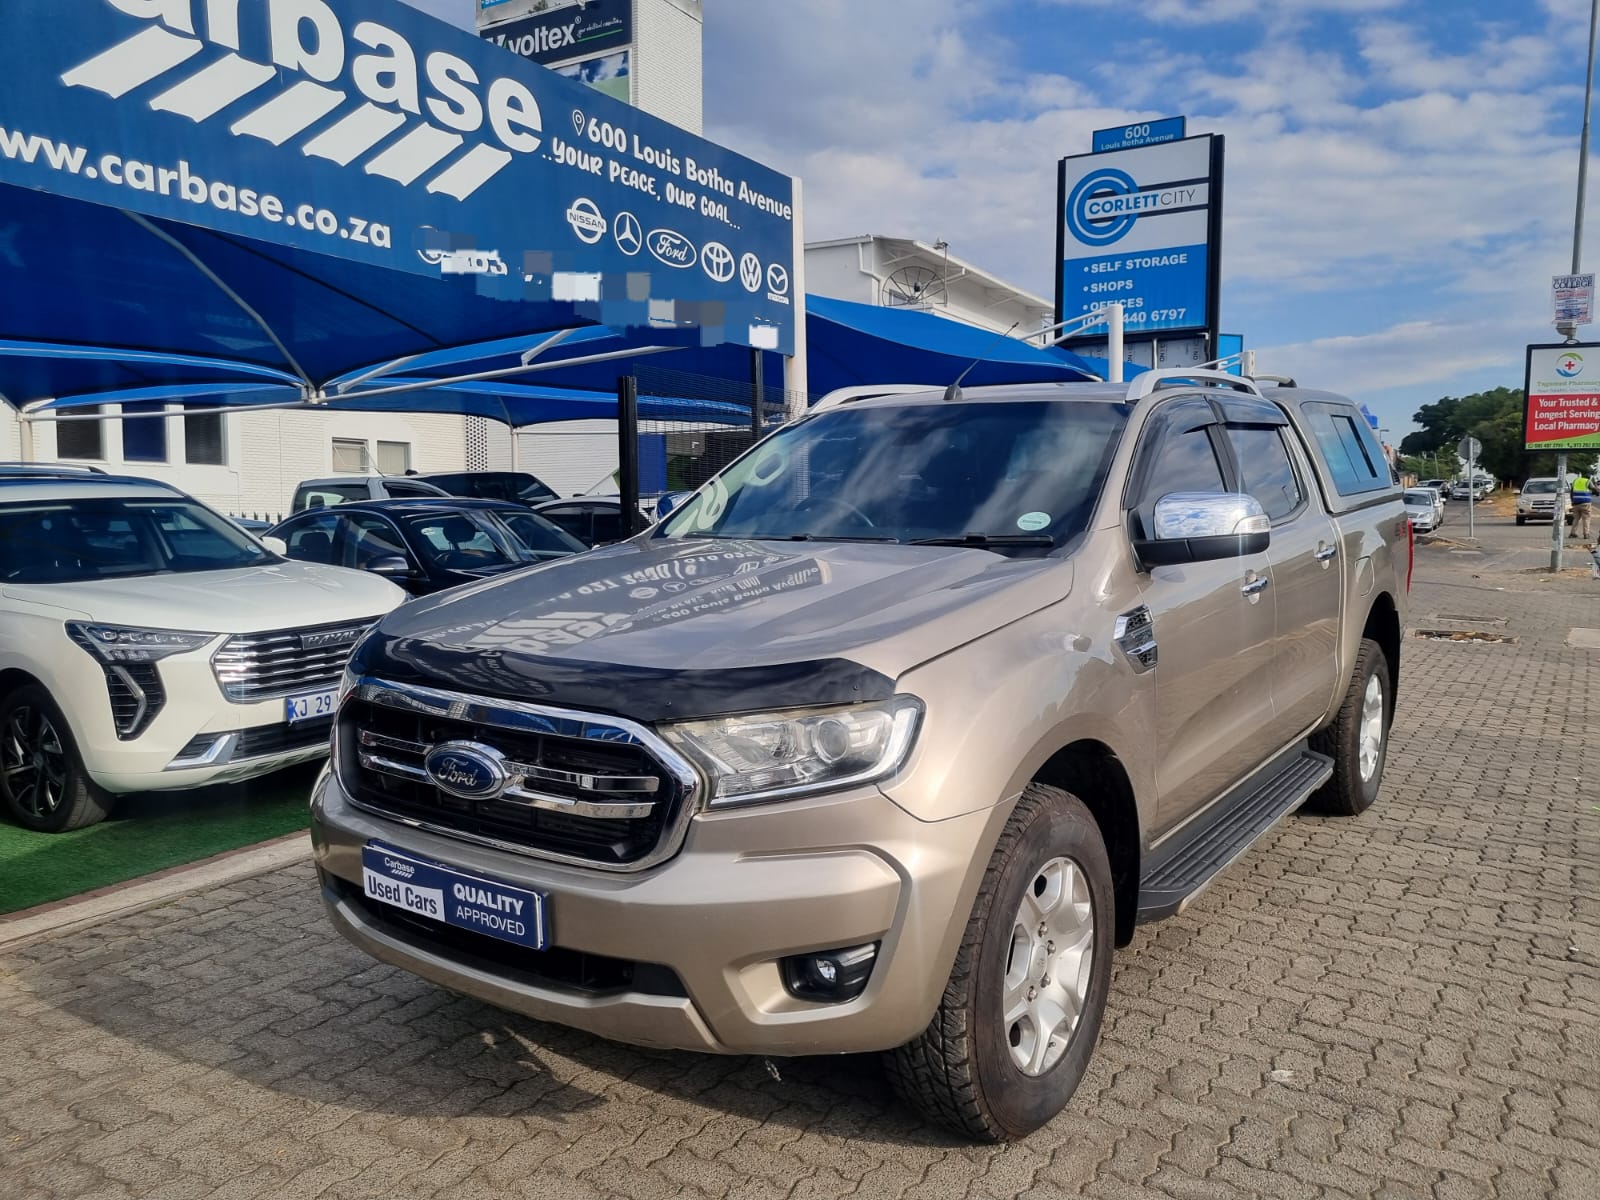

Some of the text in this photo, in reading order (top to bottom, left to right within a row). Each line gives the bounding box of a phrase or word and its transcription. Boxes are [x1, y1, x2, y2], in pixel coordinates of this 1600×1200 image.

[1125, 124, 1151, 139] 600
[1101, 133, 1174, 151] Louis Botha Avenue
[588, 118, 792, 220] 600 Louis Botha Avenue
[609, 160, 661, 201] PEACE,
[666, 182, 696, 210] OUR
[569, 212, 605, 230] NISSAN
[656, 234, 688, 262] Ford
[1091, 254, 1188, 273] SELF STORAGE
[1090, 280, 1133, 293] SHOPS
[1554, 279, 1592, 289] COLLEGE
[1151, 308, 1186, 321] 6797
[1539, 398, 1598, 407] Your Trusted &
[1535, 410, 1600, 420] Longest Serving
[1535, 421, 1599, 431] Local Pharmacy
[292, 695, 331, 718] KJ 29
[438, 758, 478, 787] Ford
[384, 857, 415, 874] Carbase
[368, 875, 438, 915] Used Cars
[453, 883, 524, 916] QUALITY
[456, 905, 525, 937] APPROVED
